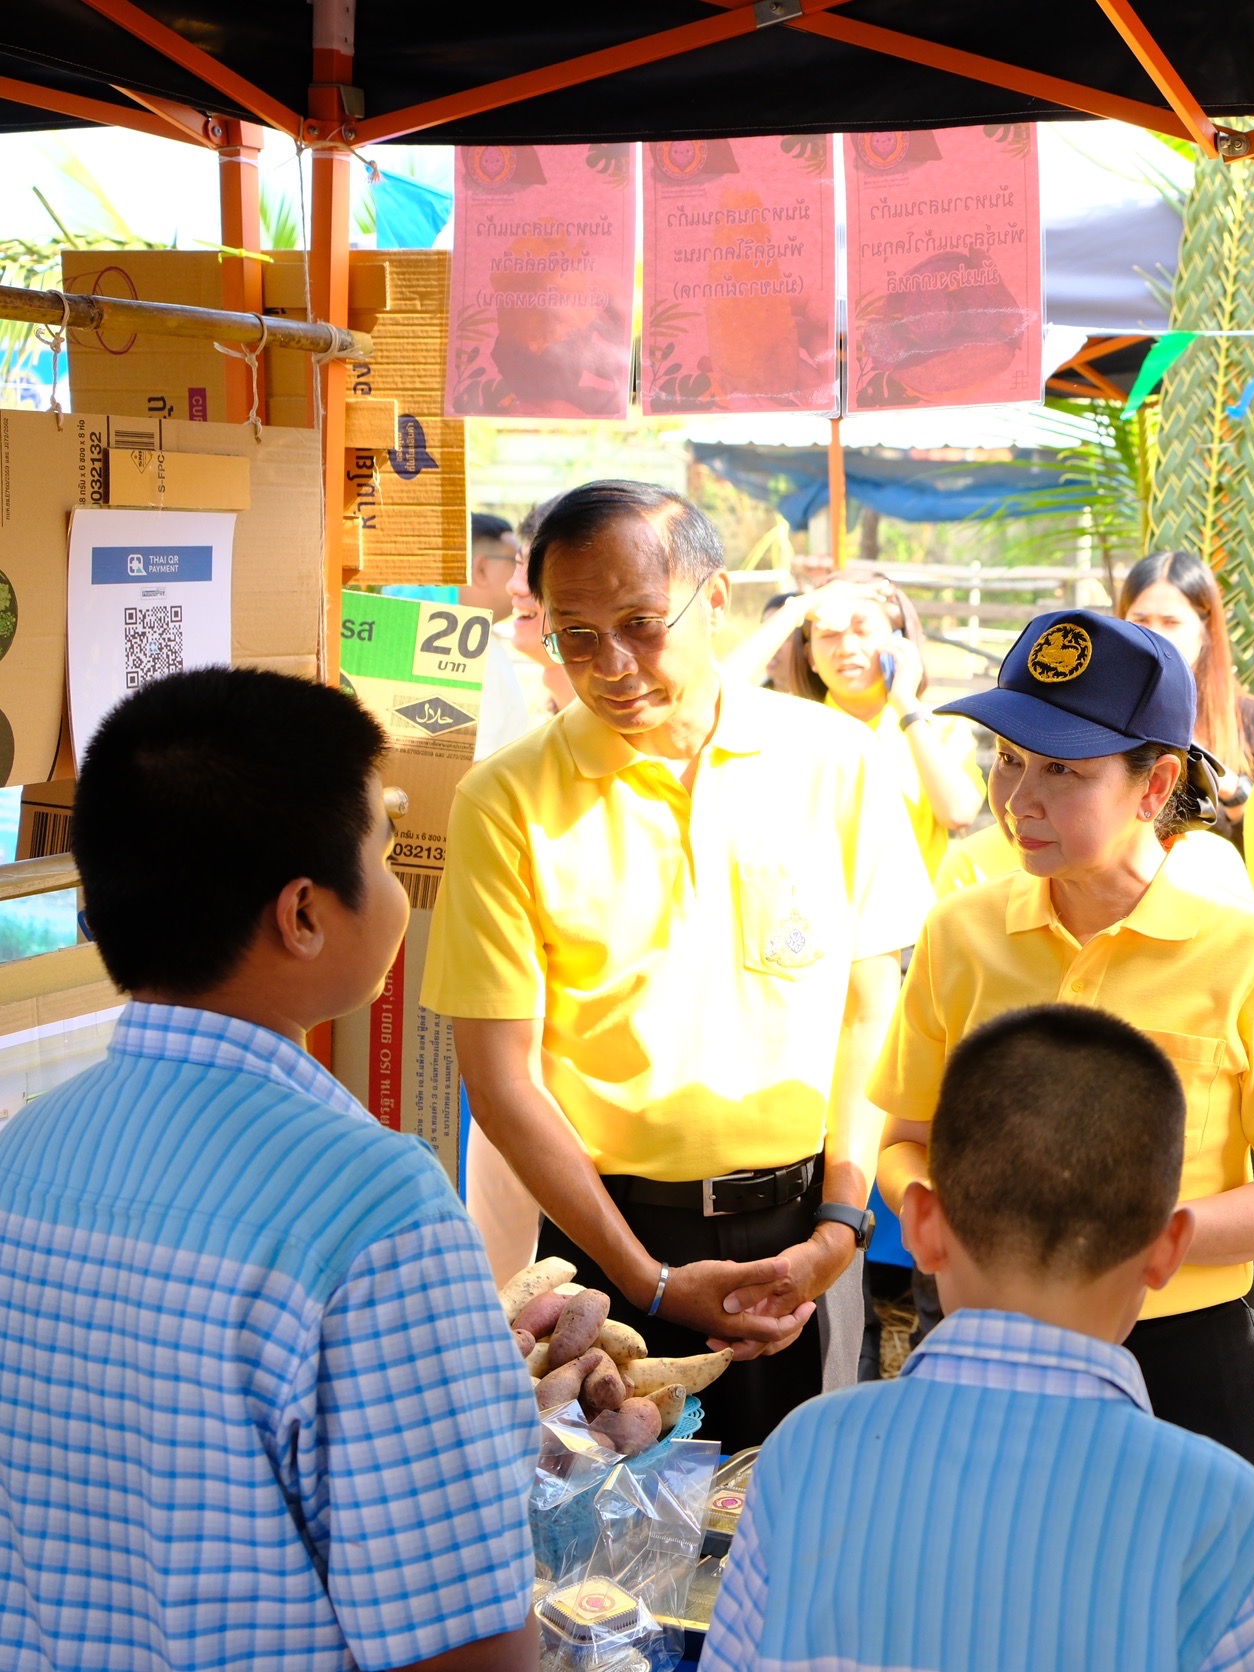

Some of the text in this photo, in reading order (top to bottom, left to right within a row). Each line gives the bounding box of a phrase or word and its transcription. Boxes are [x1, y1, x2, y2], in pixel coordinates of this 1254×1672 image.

[89, 431, 102, 505] 032132
[148, 564, 179, 573] PAYMENT
[149, 555, 179, 565] THAI QR
[420, 611, 491, 660] 20
[437, 660, 467, 674] บาท
[415, 703, 454, 725] حلال
[421, 832, 427, 841] 6
[379, 1049, 392, 1075] ISO
